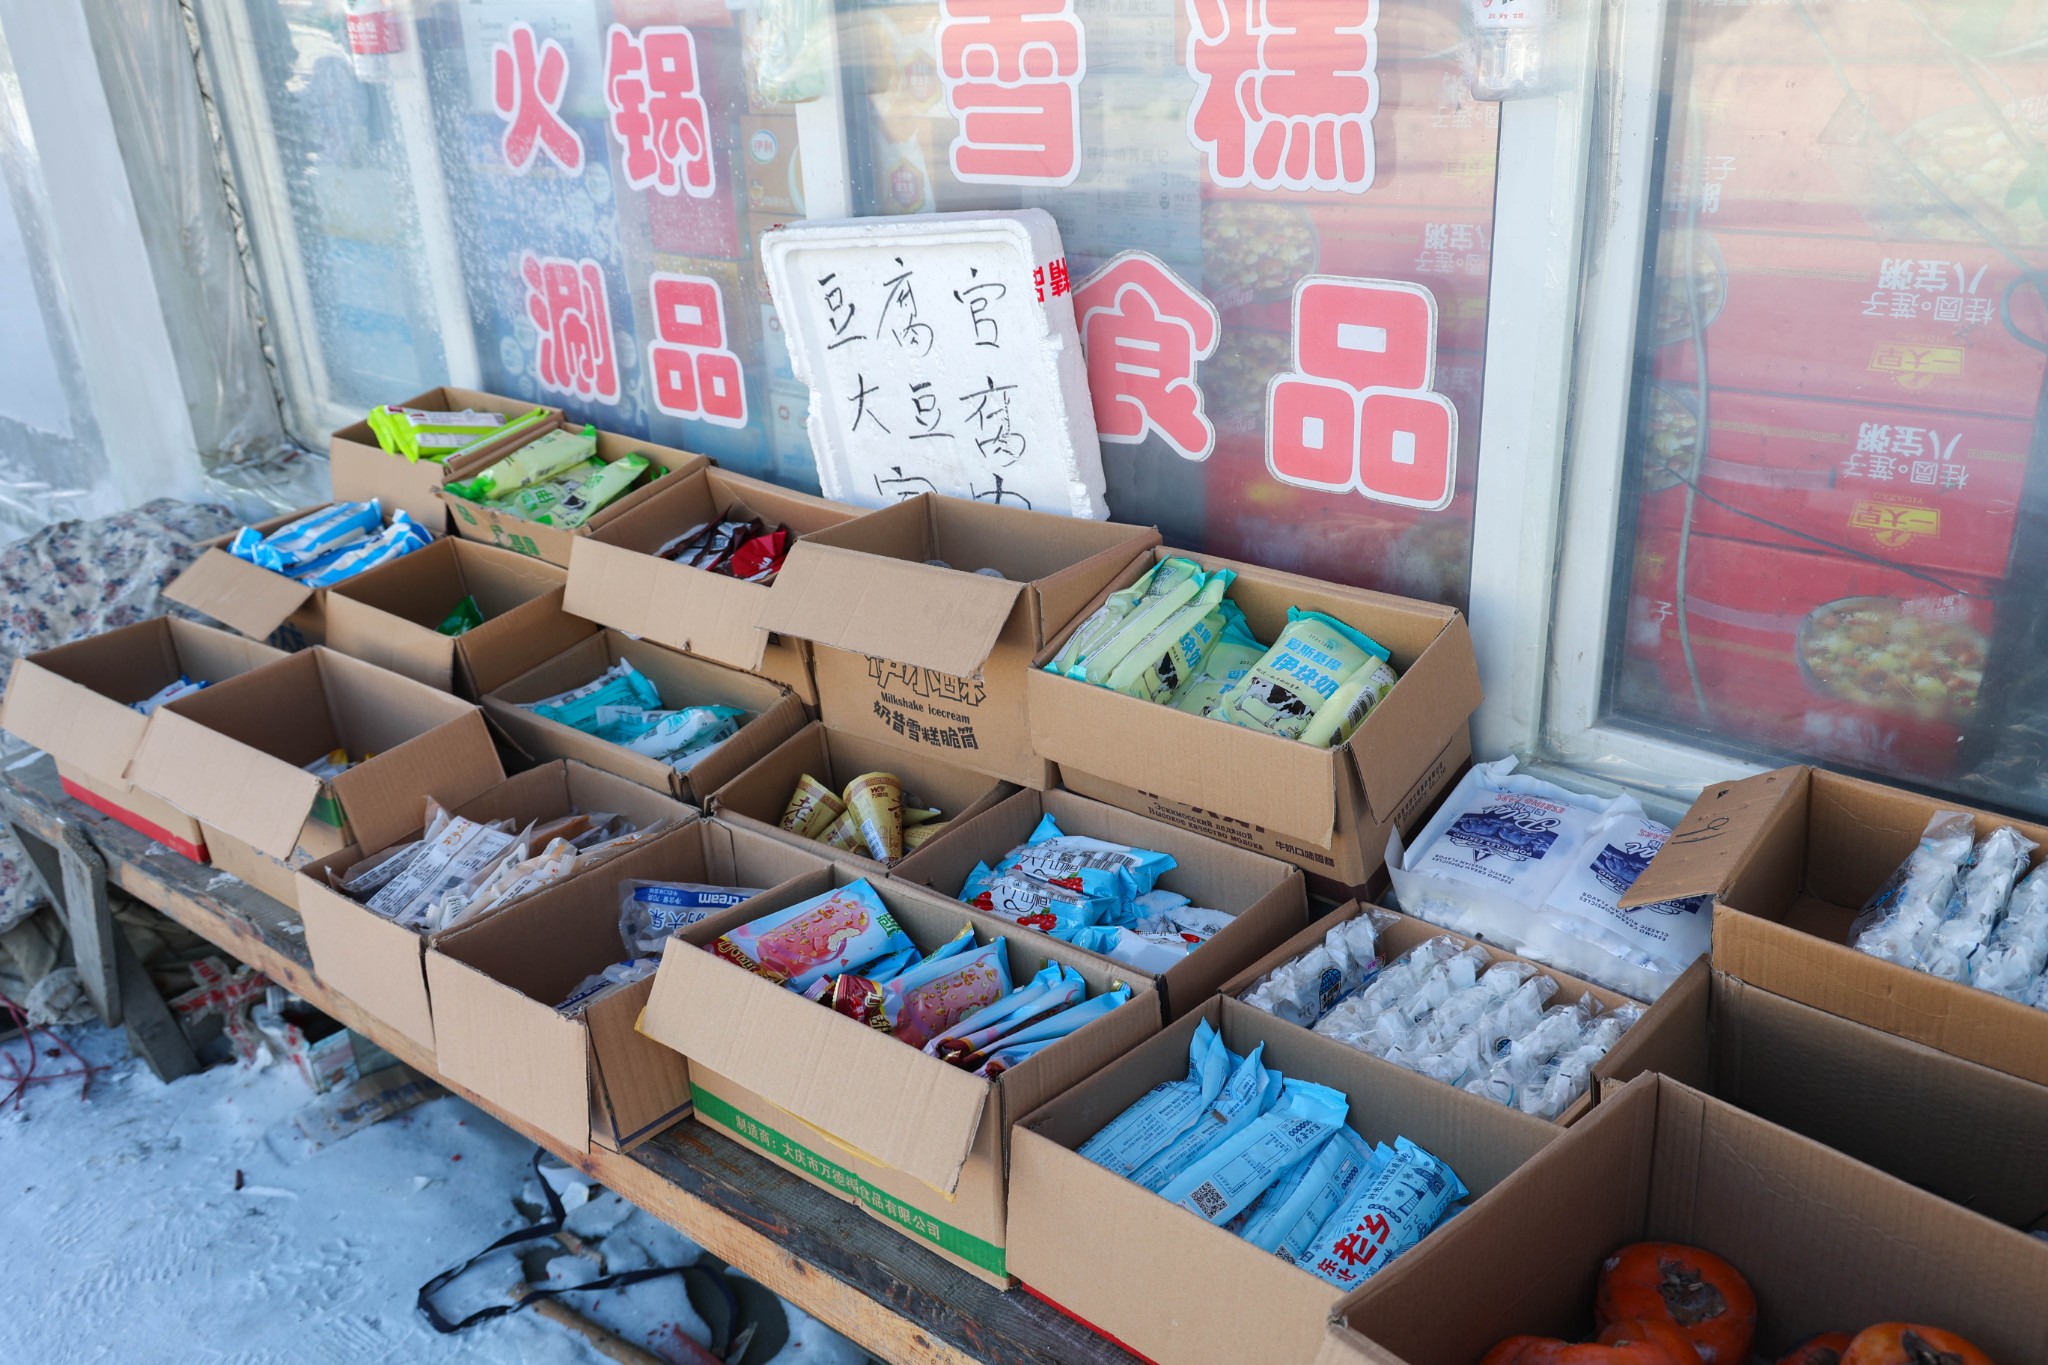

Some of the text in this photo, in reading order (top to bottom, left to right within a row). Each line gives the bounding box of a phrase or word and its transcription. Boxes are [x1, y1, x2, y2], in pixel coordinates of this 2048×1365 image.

[492, 20, 715, 198] 火锅
[1877, 257, 1988, 294] 八宝粥
[519, 248, 748, 429] 涮品
[1074, 250, 1458, 511] 食品
[848, 373, 1026, 467] 大豆腐
[1856, 421, 1962, 461] 八宝粥
[1852, 502, 1935, 527] 一大早
[1284, 637, 1343, 672] 爱斯基摩
[1270, 651, 1340, 700] 伊块奶
[873, 700, 979, 750] 奶昔雪糕脆筒
[881, 691, 971, 724] Milkshake icecream
[1148, 806, 1187, 826] Высокое
[1188, 820, 1228, 840] качество
[1230, 835, 1264, 851] молока
[1154, 802, 1214, 828] Эскимосский
[1216, 823, 1254, 841] ледяной
[1275, 840, 1335, 868] 牛奶口味雪糕
[1432, 856, 1512, 884] ESKIMO CREAM POPSICLES
[1460, 861, 1487, 872] RUSSIAN
[1489, 869, 1515, 881] CLASSIC
[699, 893, 740, 905] cream
[1582, 891, 1608, 908] FLAVOR
[1579, 896, 1667, 942] ESKIMO CREAM POPSICLES
[1640, 924, 1669, 938] CLASSIC
[1317, 1257, 1358, 1282] 东北
